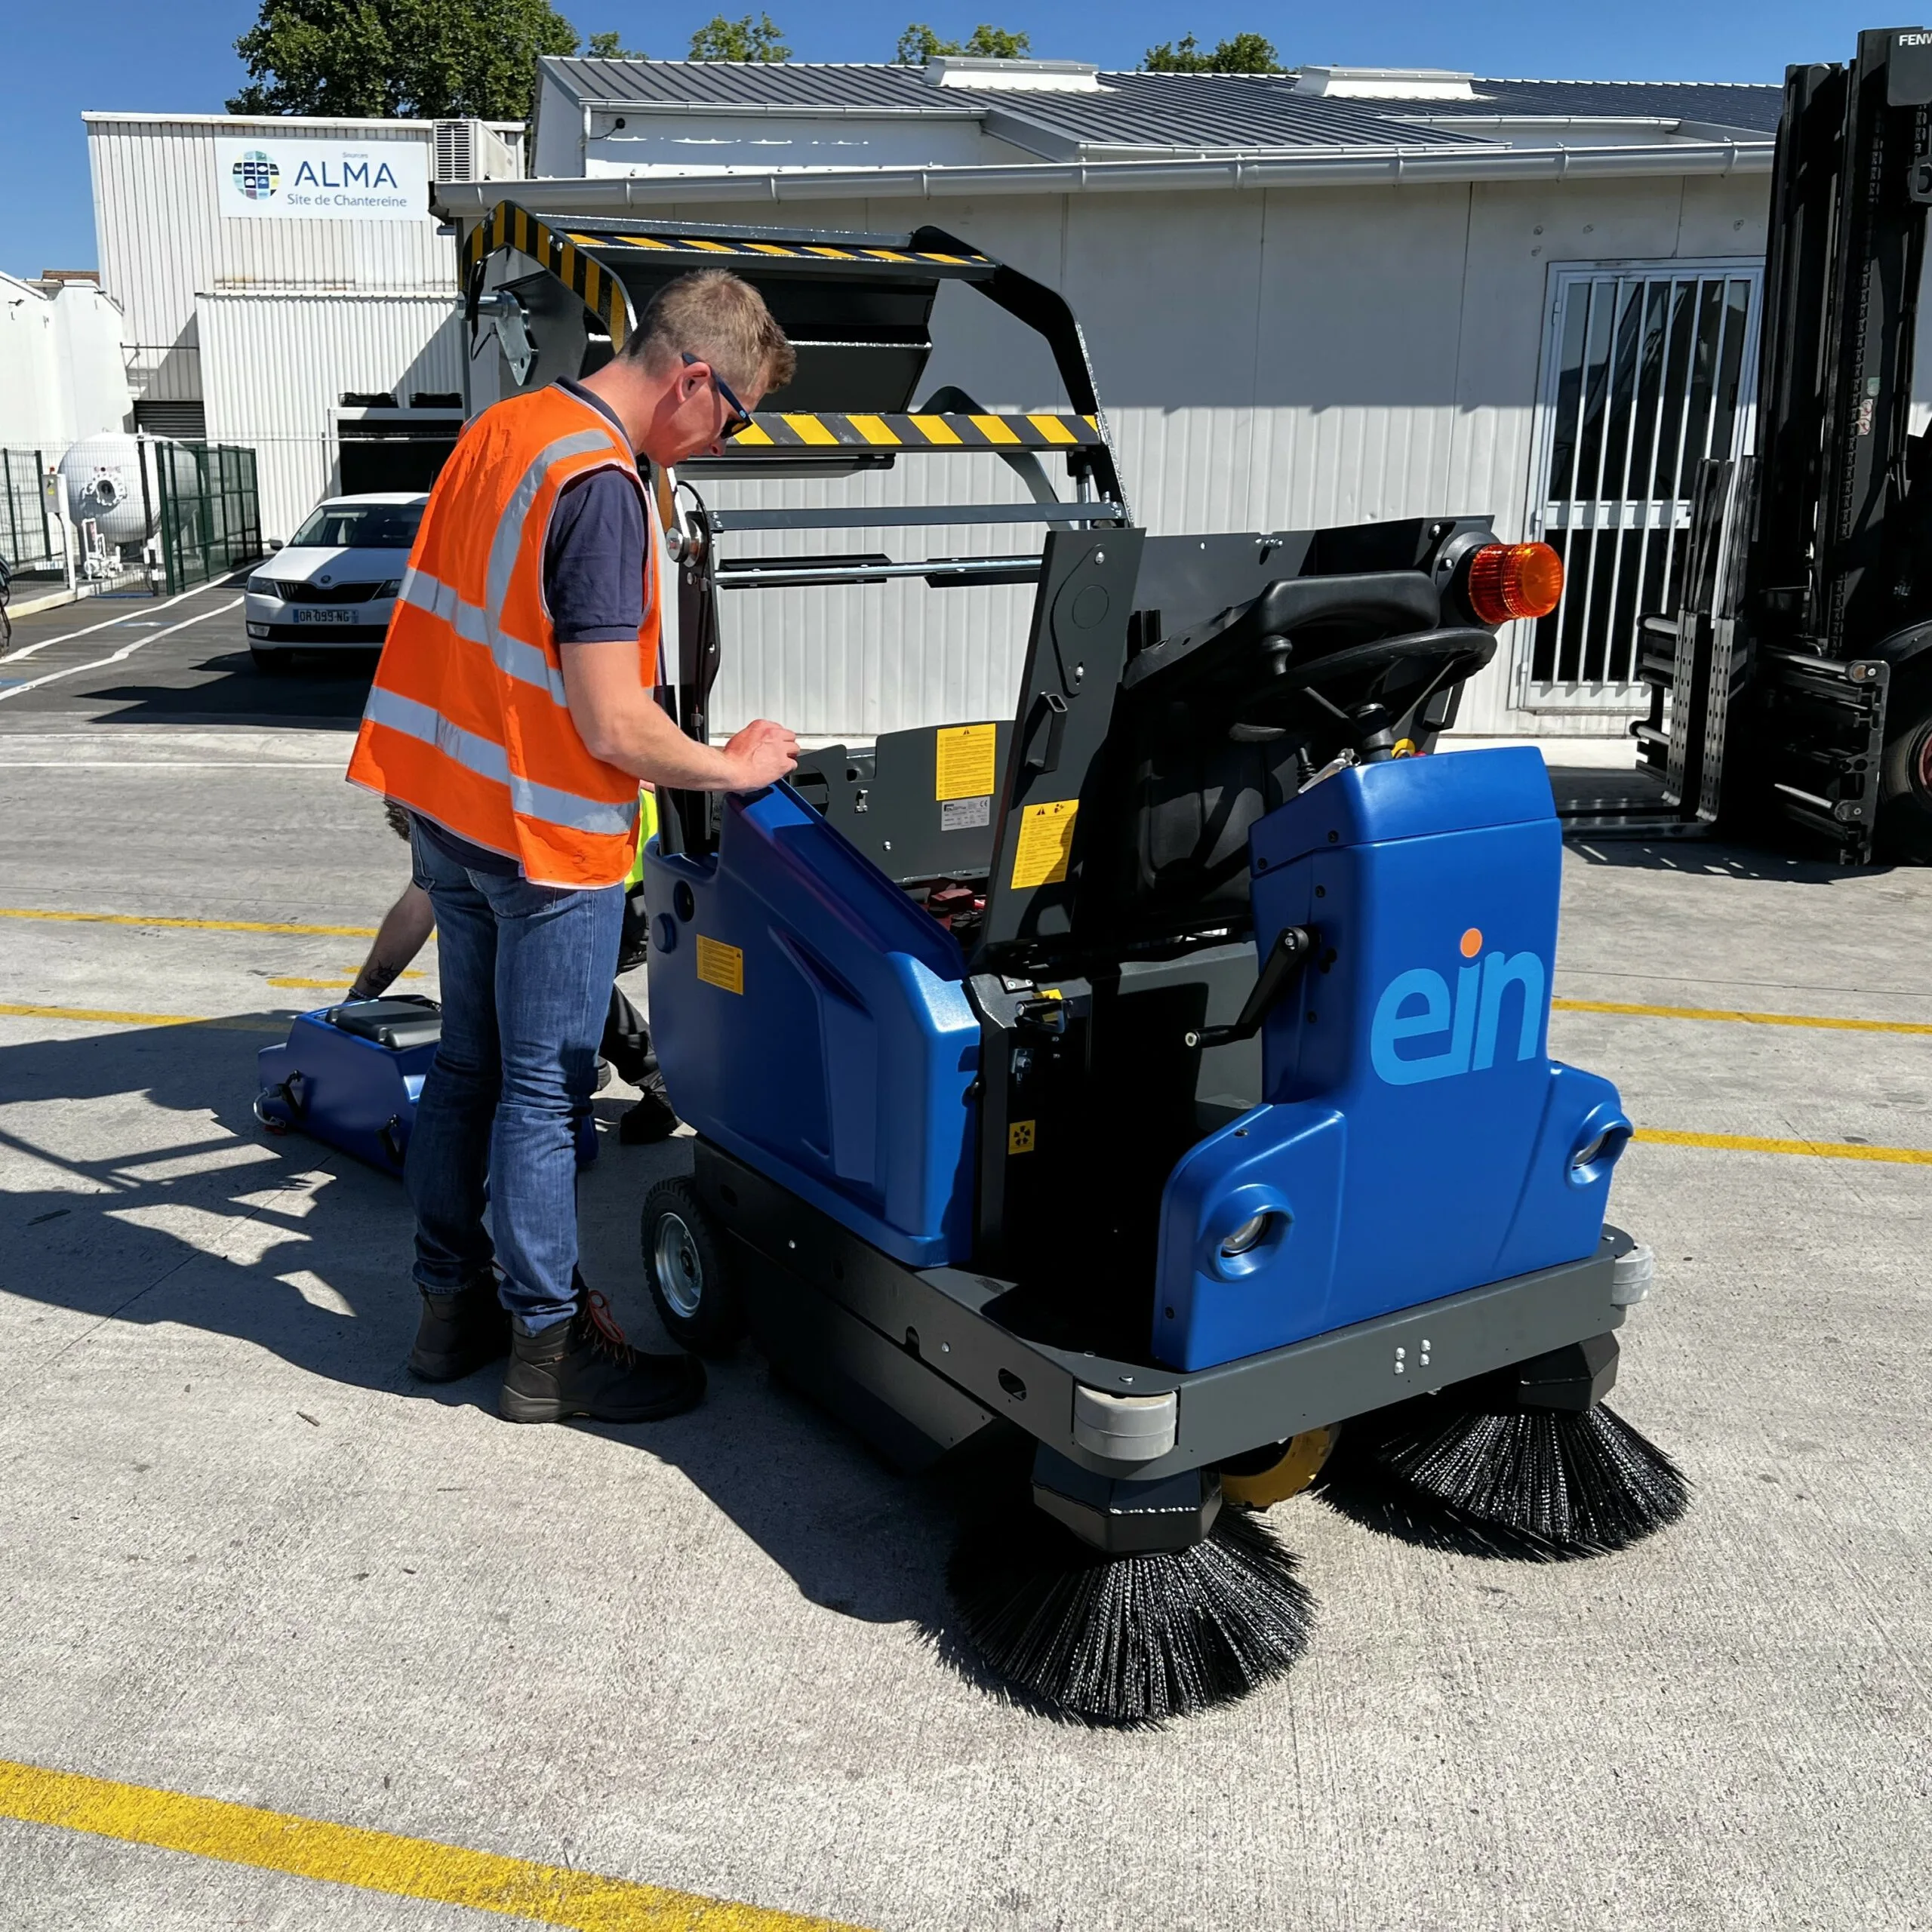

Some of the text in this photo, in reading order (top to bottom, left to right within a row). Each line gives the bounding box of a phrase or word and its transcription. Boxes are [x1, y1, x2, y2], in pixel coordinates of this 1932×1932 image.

[294, 161, 398, 189] ALMA
[288, 193, 408, 207] Site de Chantereine
